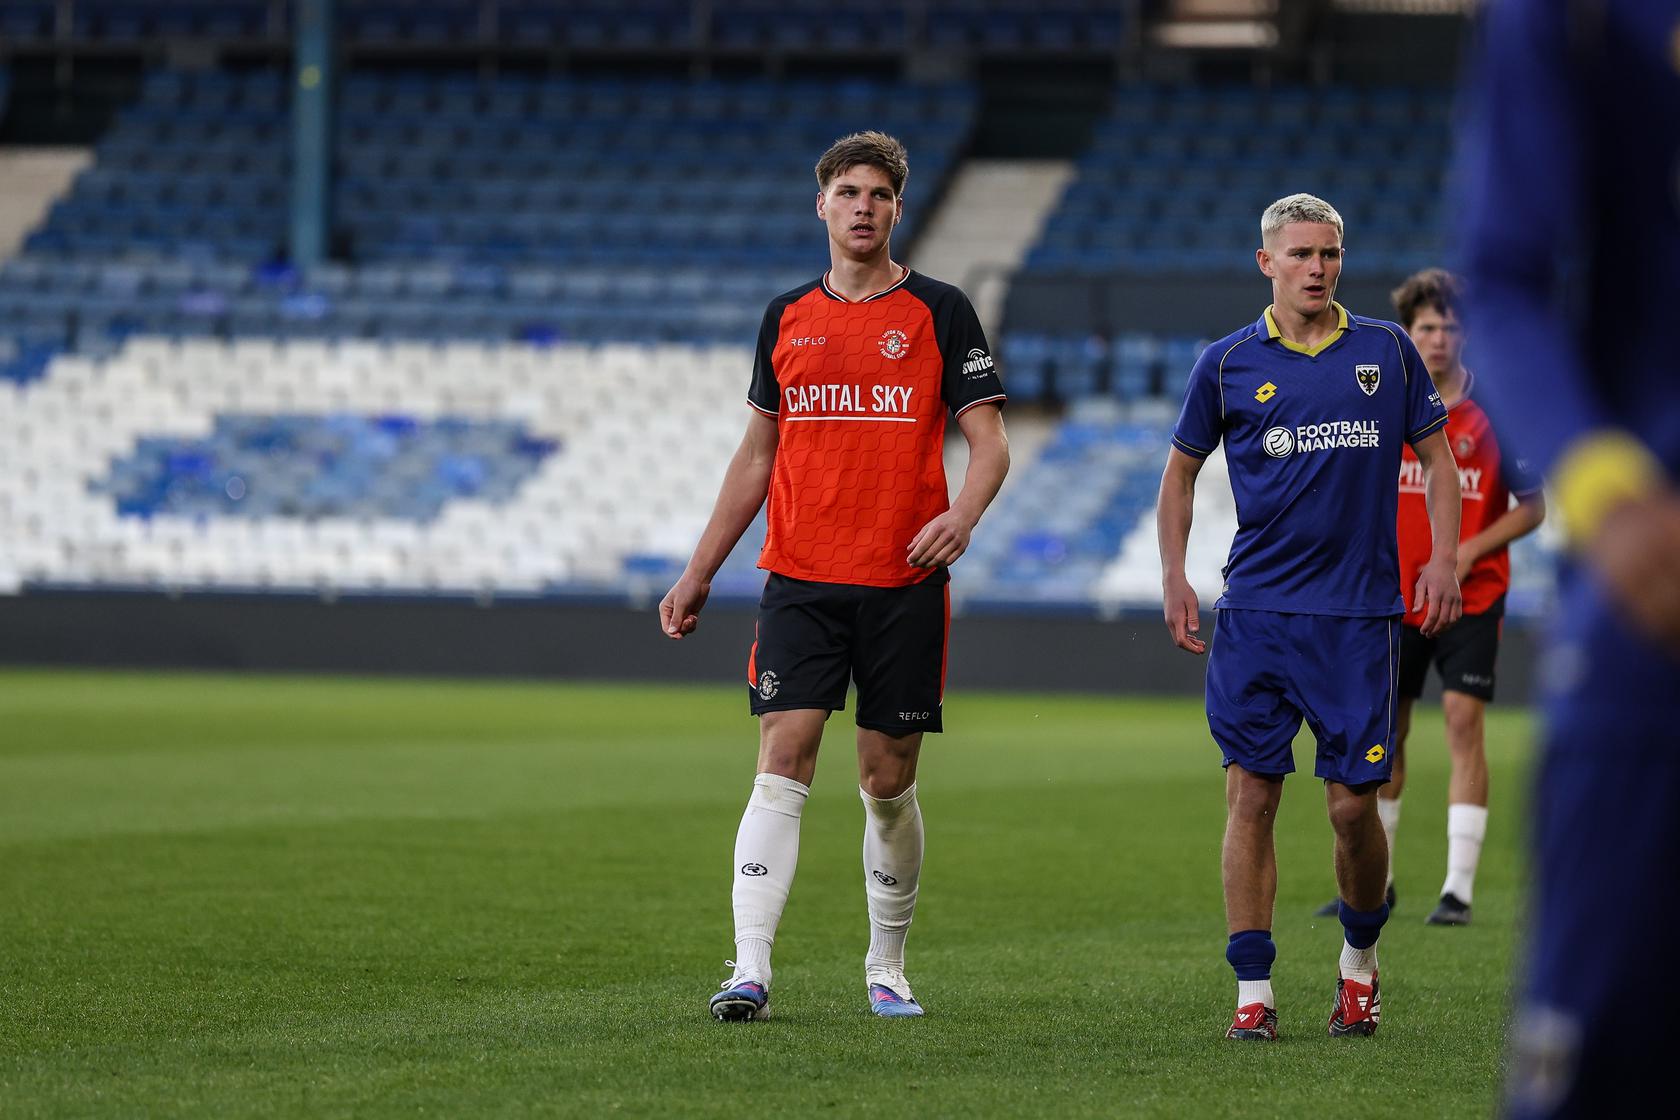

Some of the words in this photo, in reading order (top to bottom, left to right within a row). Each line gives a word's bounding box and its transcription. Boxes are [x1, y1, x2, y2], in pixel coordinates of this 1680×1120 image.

[791, 336, 826, 346] REFLO
[785, 384, 866, 413] CAPITAL
[871, 384, 913, 413] SKY
[1296, 420, 1380, 440] FOOTBALL
[1297, 434, 1380, 453] MANAGER
[898, 711, 929, 721] REFLO
